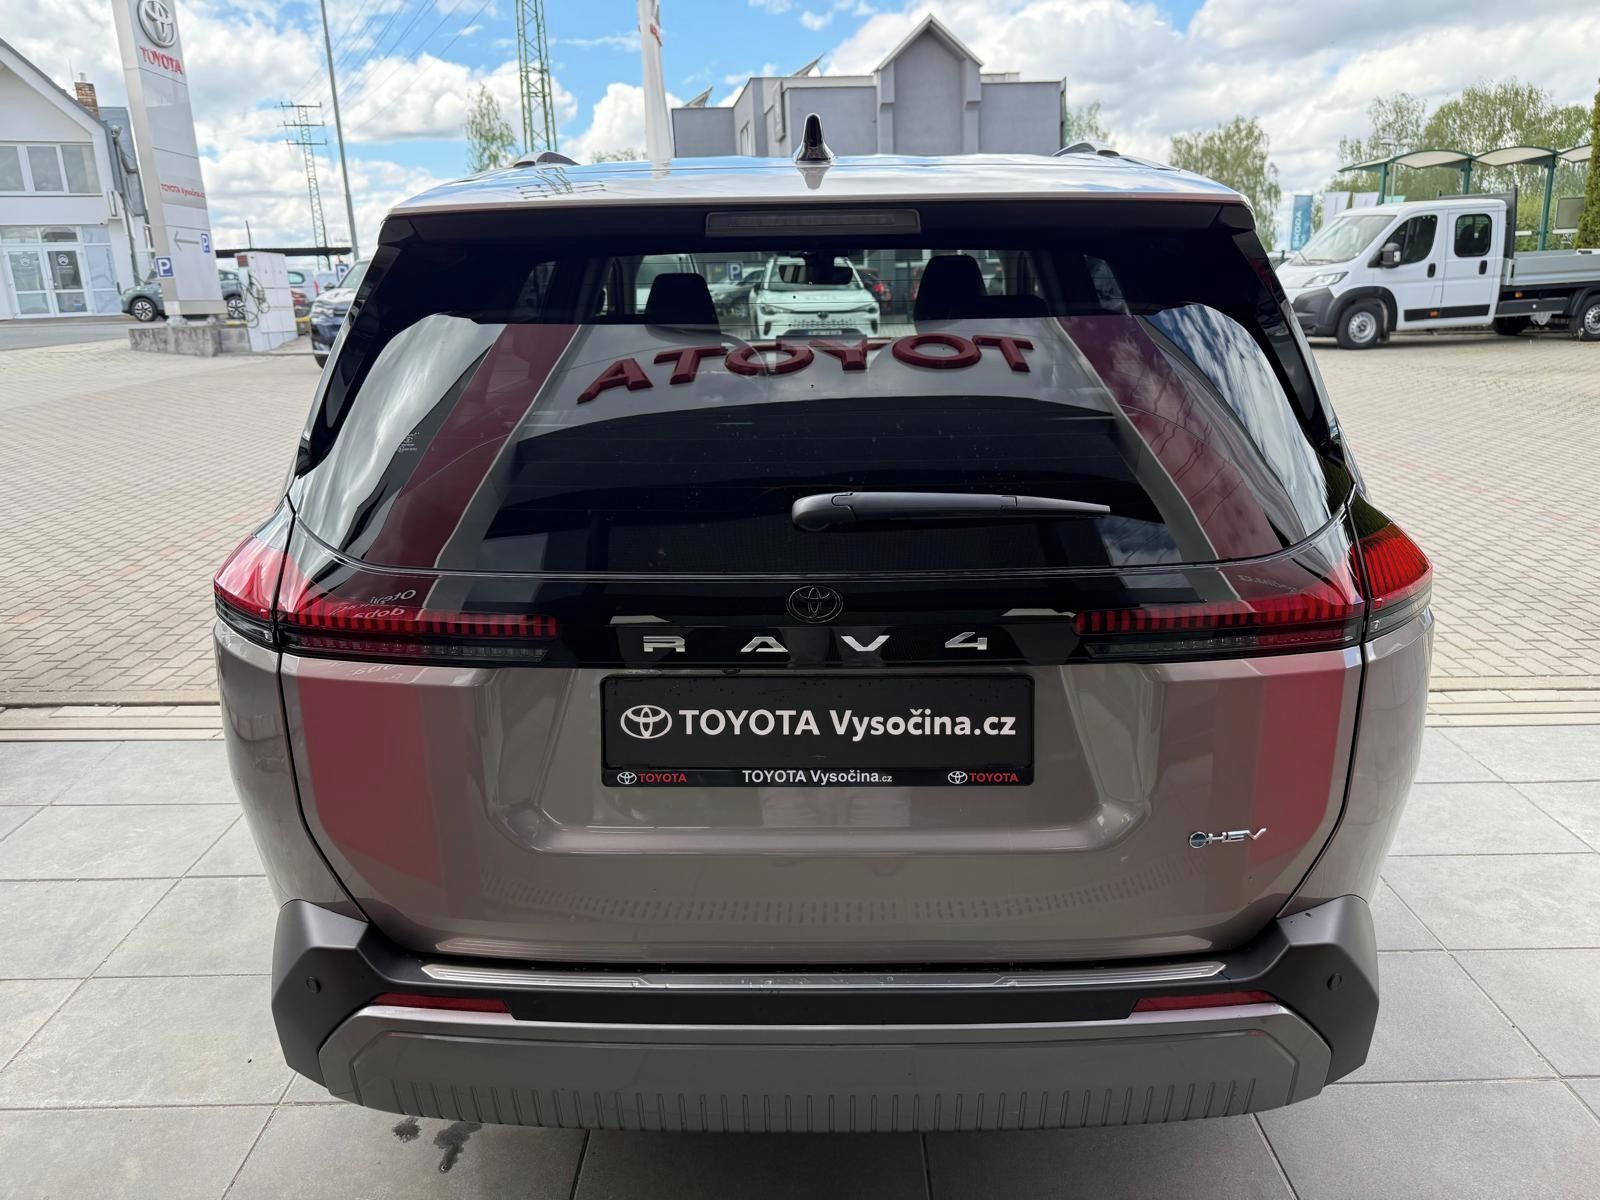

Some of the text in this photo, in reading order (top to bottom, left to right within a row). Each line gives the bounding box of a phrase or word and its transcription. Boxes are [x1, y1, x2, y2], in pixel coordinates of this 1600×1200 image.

[139, 46, 183, 75] TOYOTA
[157, 258, 171, 276] P
[730, 264, 741, 279] P
[643, 631, 988, 653] RAV4
[679, 708, 1017, 742] TOYOTA Vysočina.cz
[638, 773, 688, 783] TOYOTA
[742, 769, 893, 786] TOYOTA Vysočina.cz
[969, 772, 1020, 783] TOYOTA
